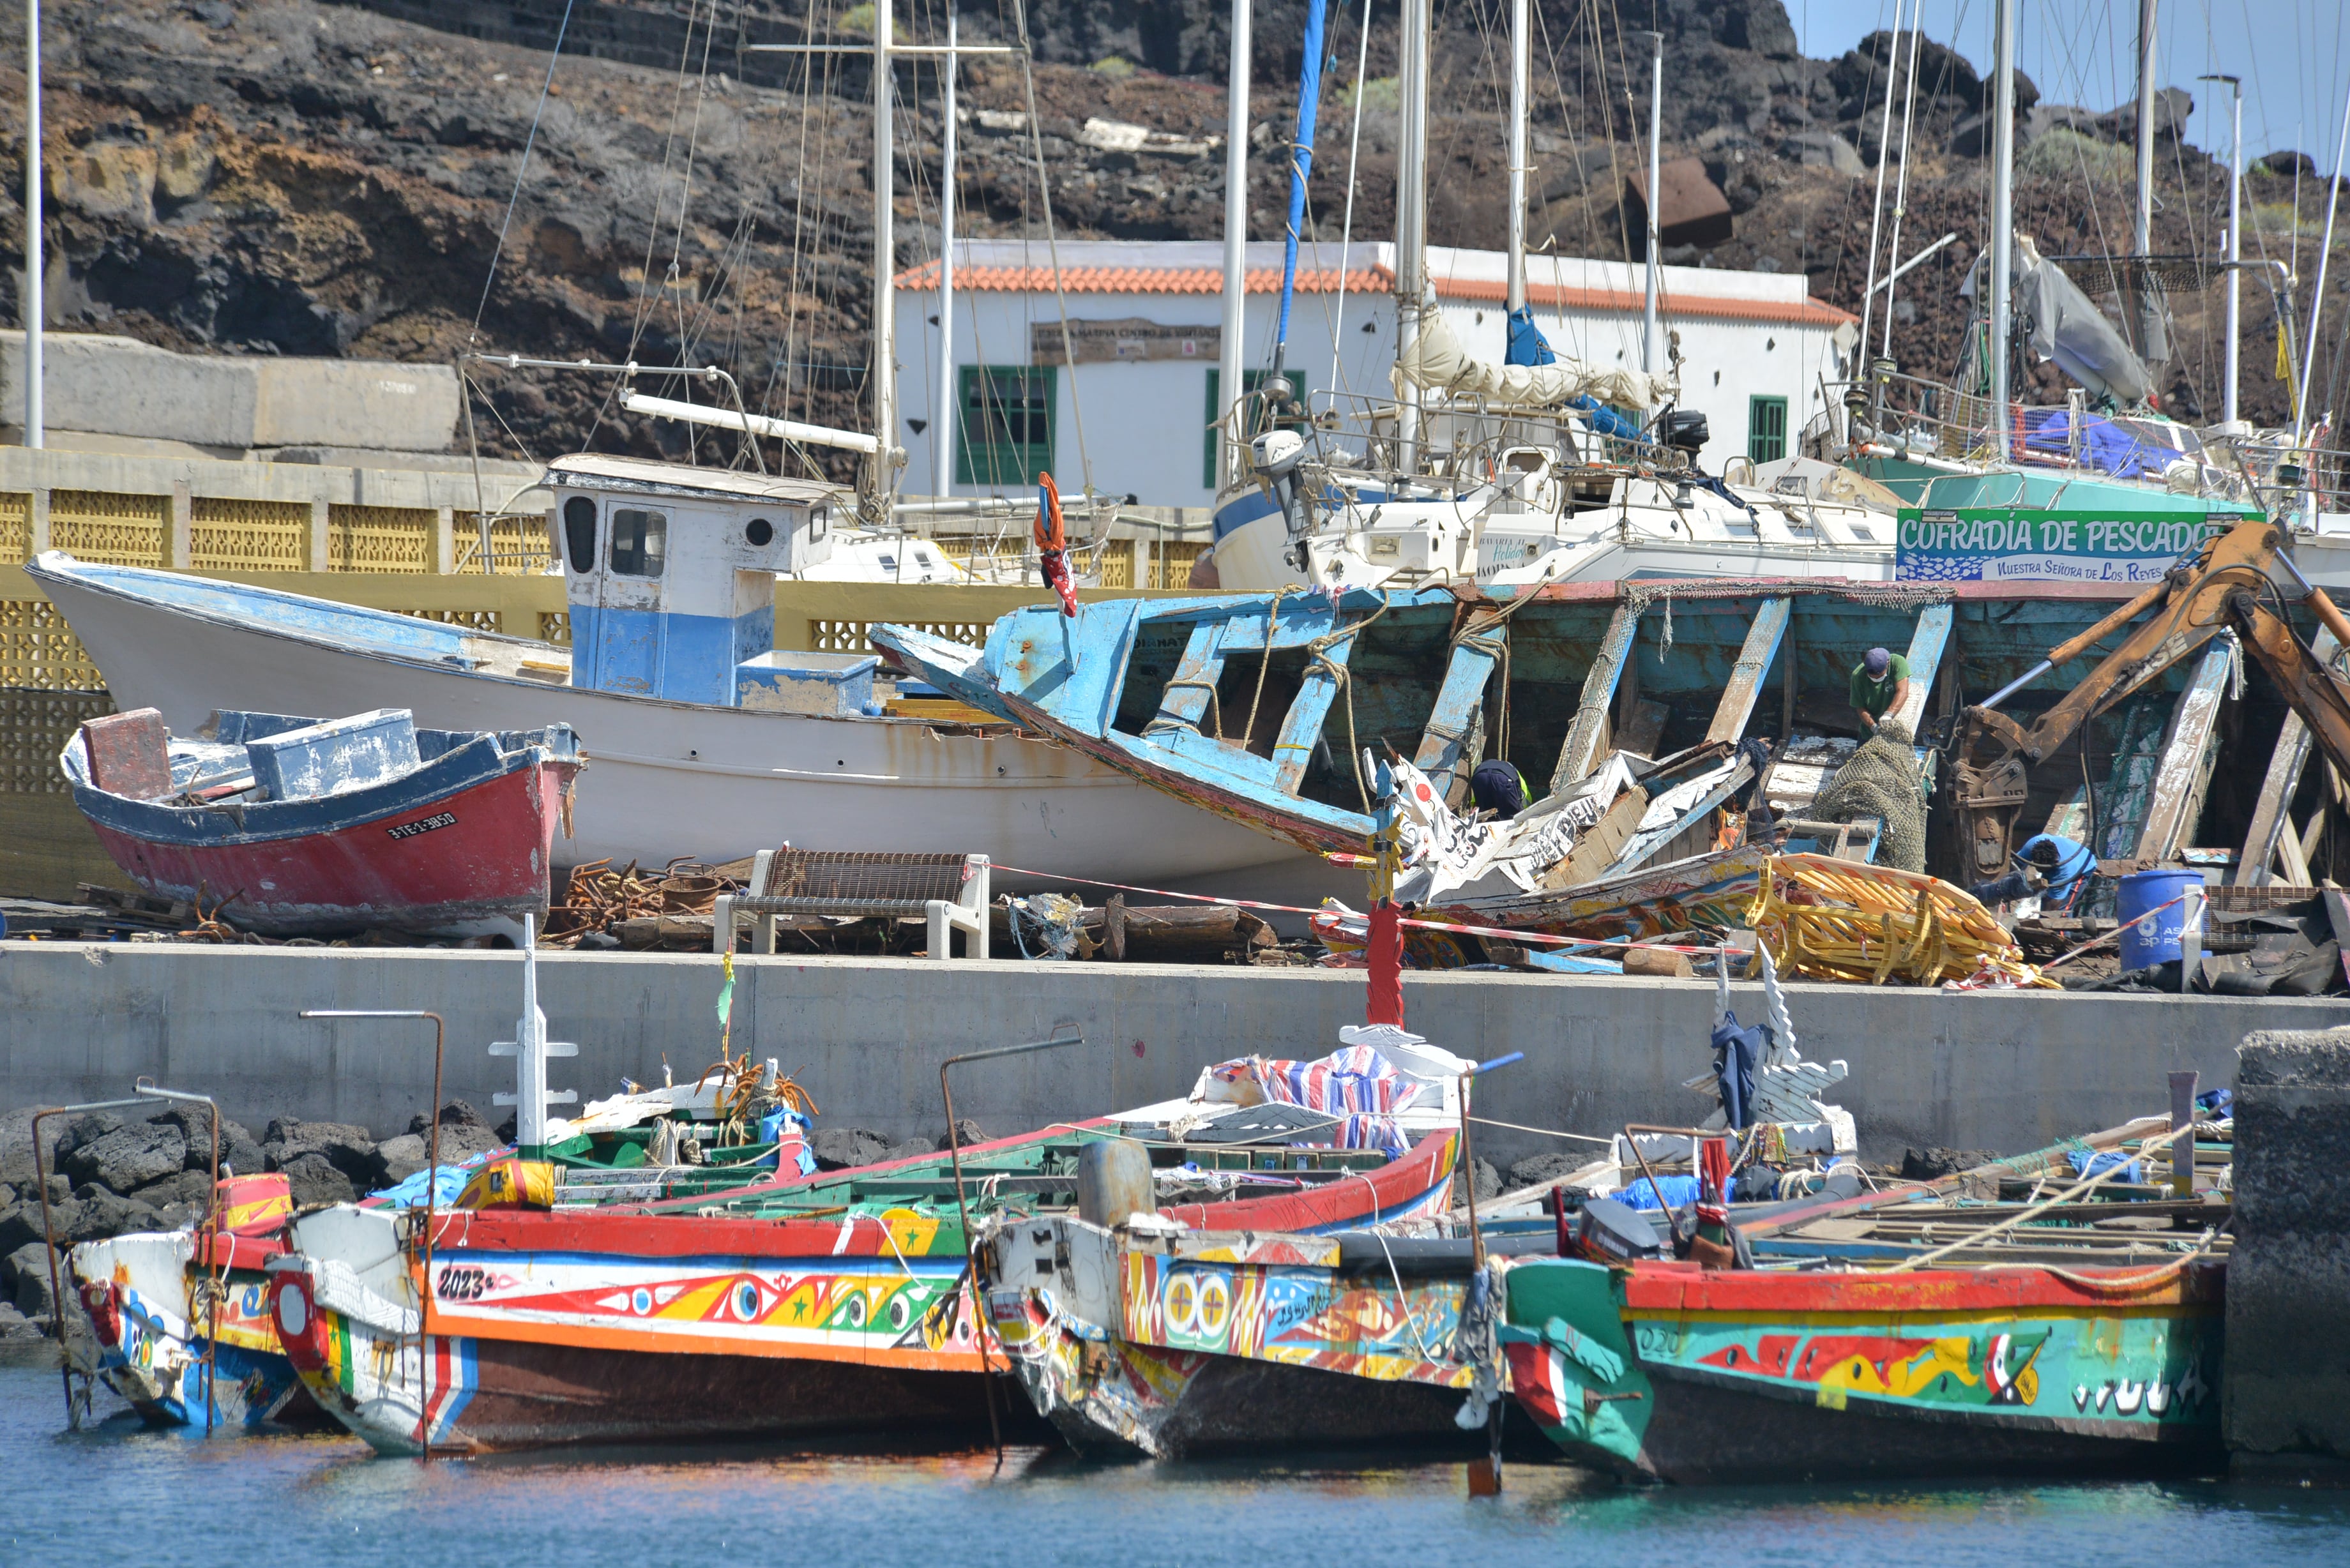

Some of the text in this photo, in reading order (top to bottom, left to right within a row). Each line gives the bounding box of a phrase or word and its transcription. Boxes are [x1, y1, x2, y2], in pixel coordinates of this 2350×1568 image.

[1900, 512, 2033, 550] COFRADÍA
[2039, 520, 2077, 552] DE
[1493, 542, 1526, 562] Holiday
[439, 1269, 485, 1300] 2023
